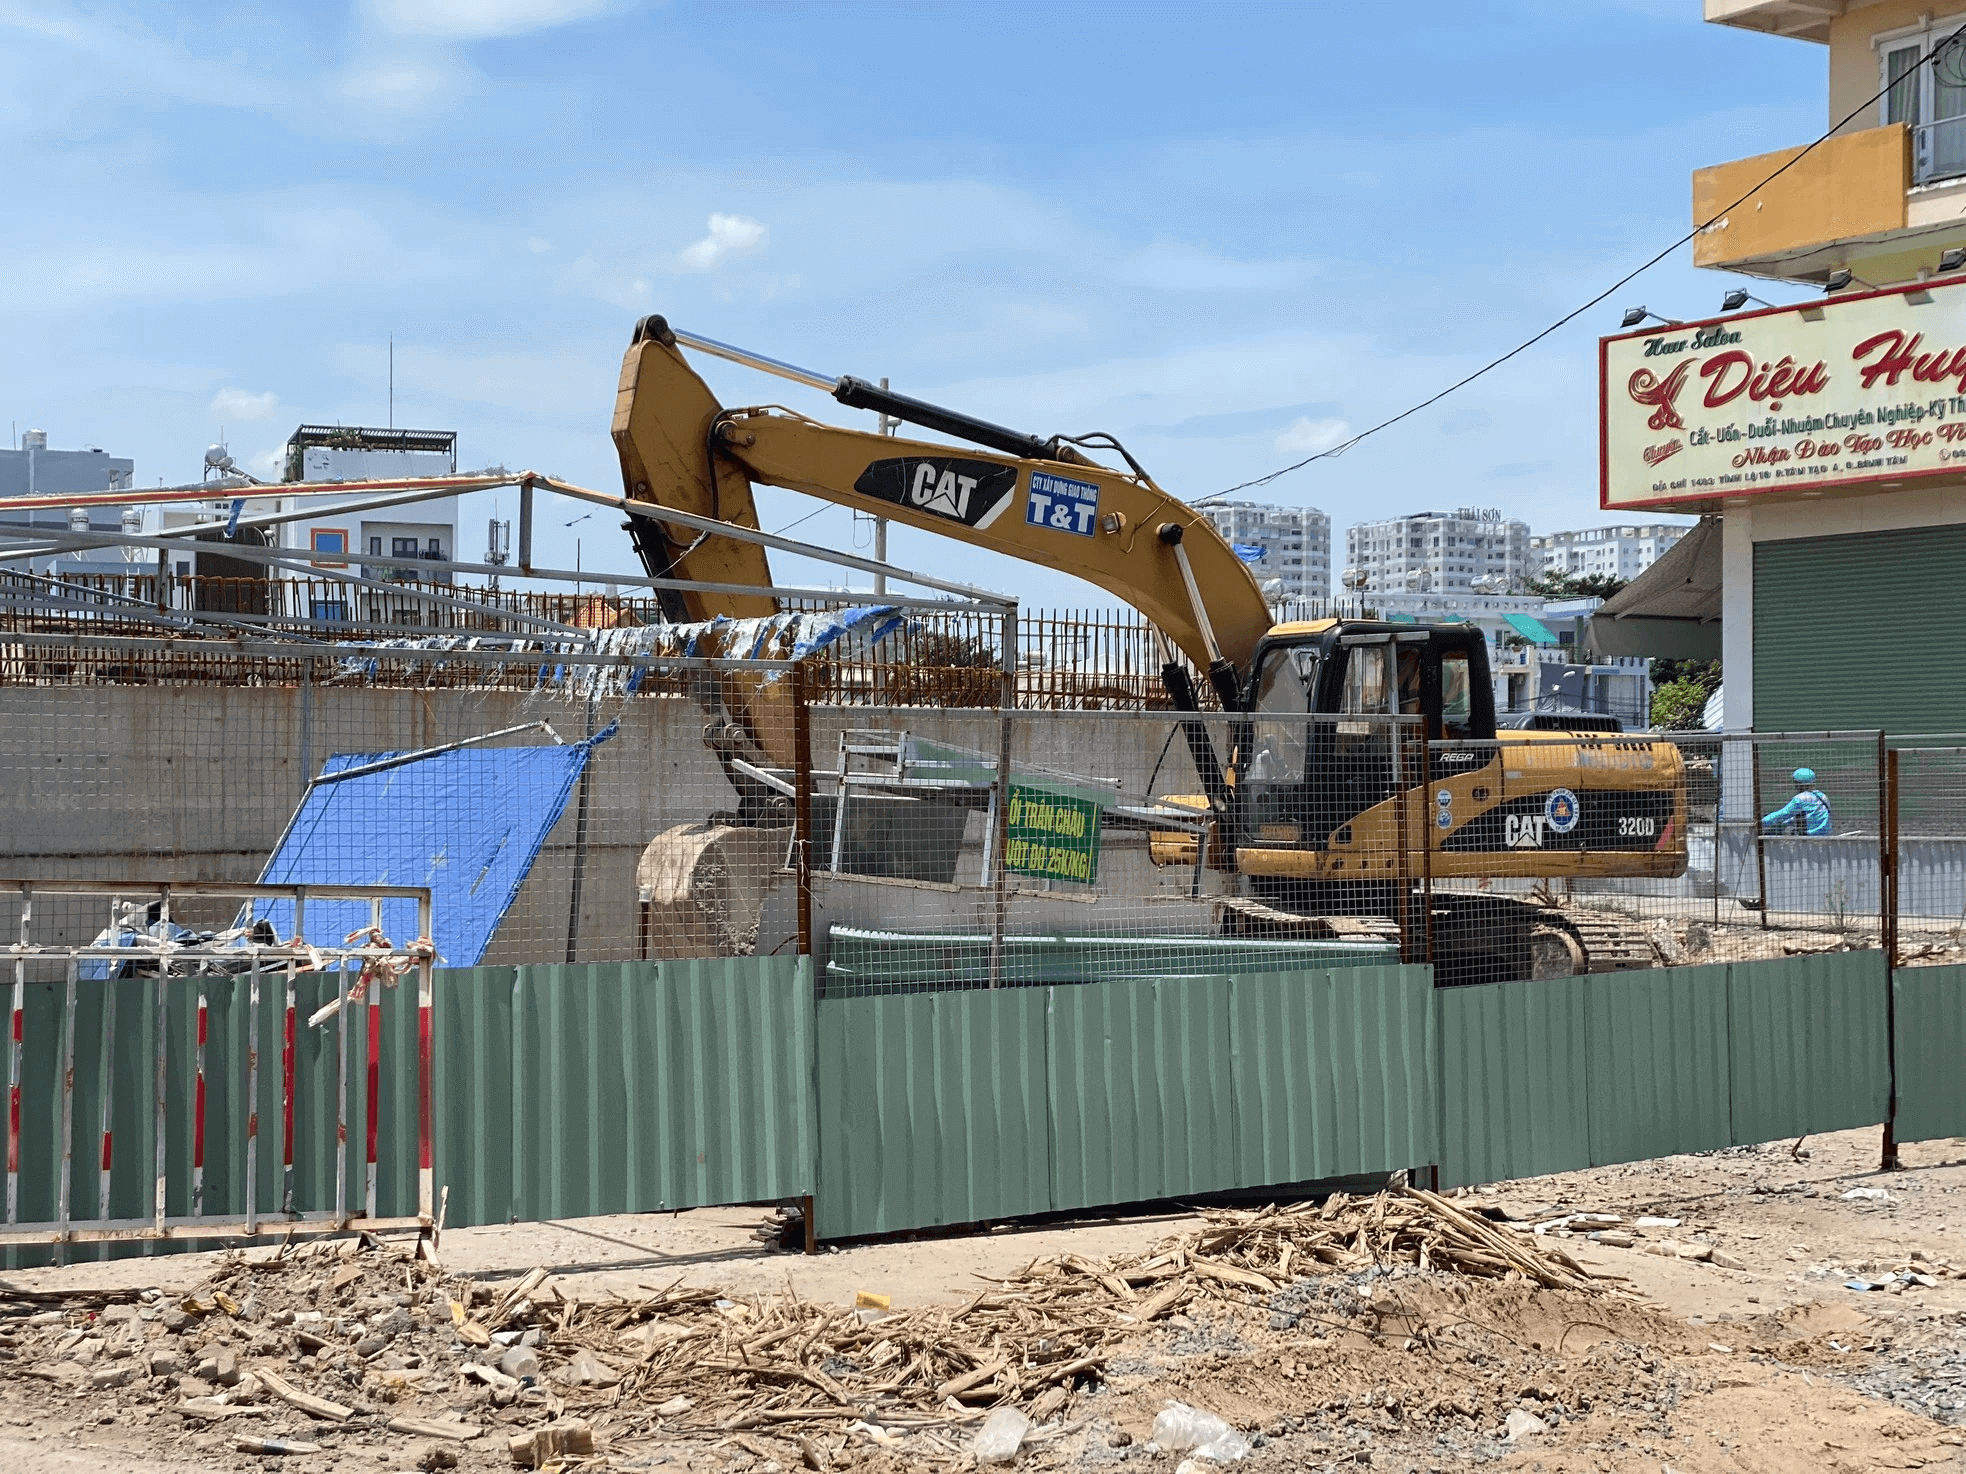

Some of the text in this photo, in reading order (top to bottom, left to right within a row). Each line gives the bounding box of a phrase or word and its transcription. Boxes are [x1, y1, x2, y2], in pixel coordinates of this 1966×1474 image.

[1691, 327, 1743, 349] Salon
[1700, 349, 1829, 411] Diệu
[1825, 408, 1874, 430] Chuyên
[1732, 446, 1791, 468] Nhận
[1795, 439, 1841, 459] Đào
[1843, 433, 1884, 455] Tạo
[1886, 428, 1933, 450] Học
[911, 463, 978, 519] CAT
[1042, 475, 1054, 492] XÂY
[1031, 492, 1096, 533] T&T
[1458, 505, 1501, 521] THÁI SƠN
[1505, 814, 1546, 847] CAT
[1618, 816, 1655, 836] 320D
